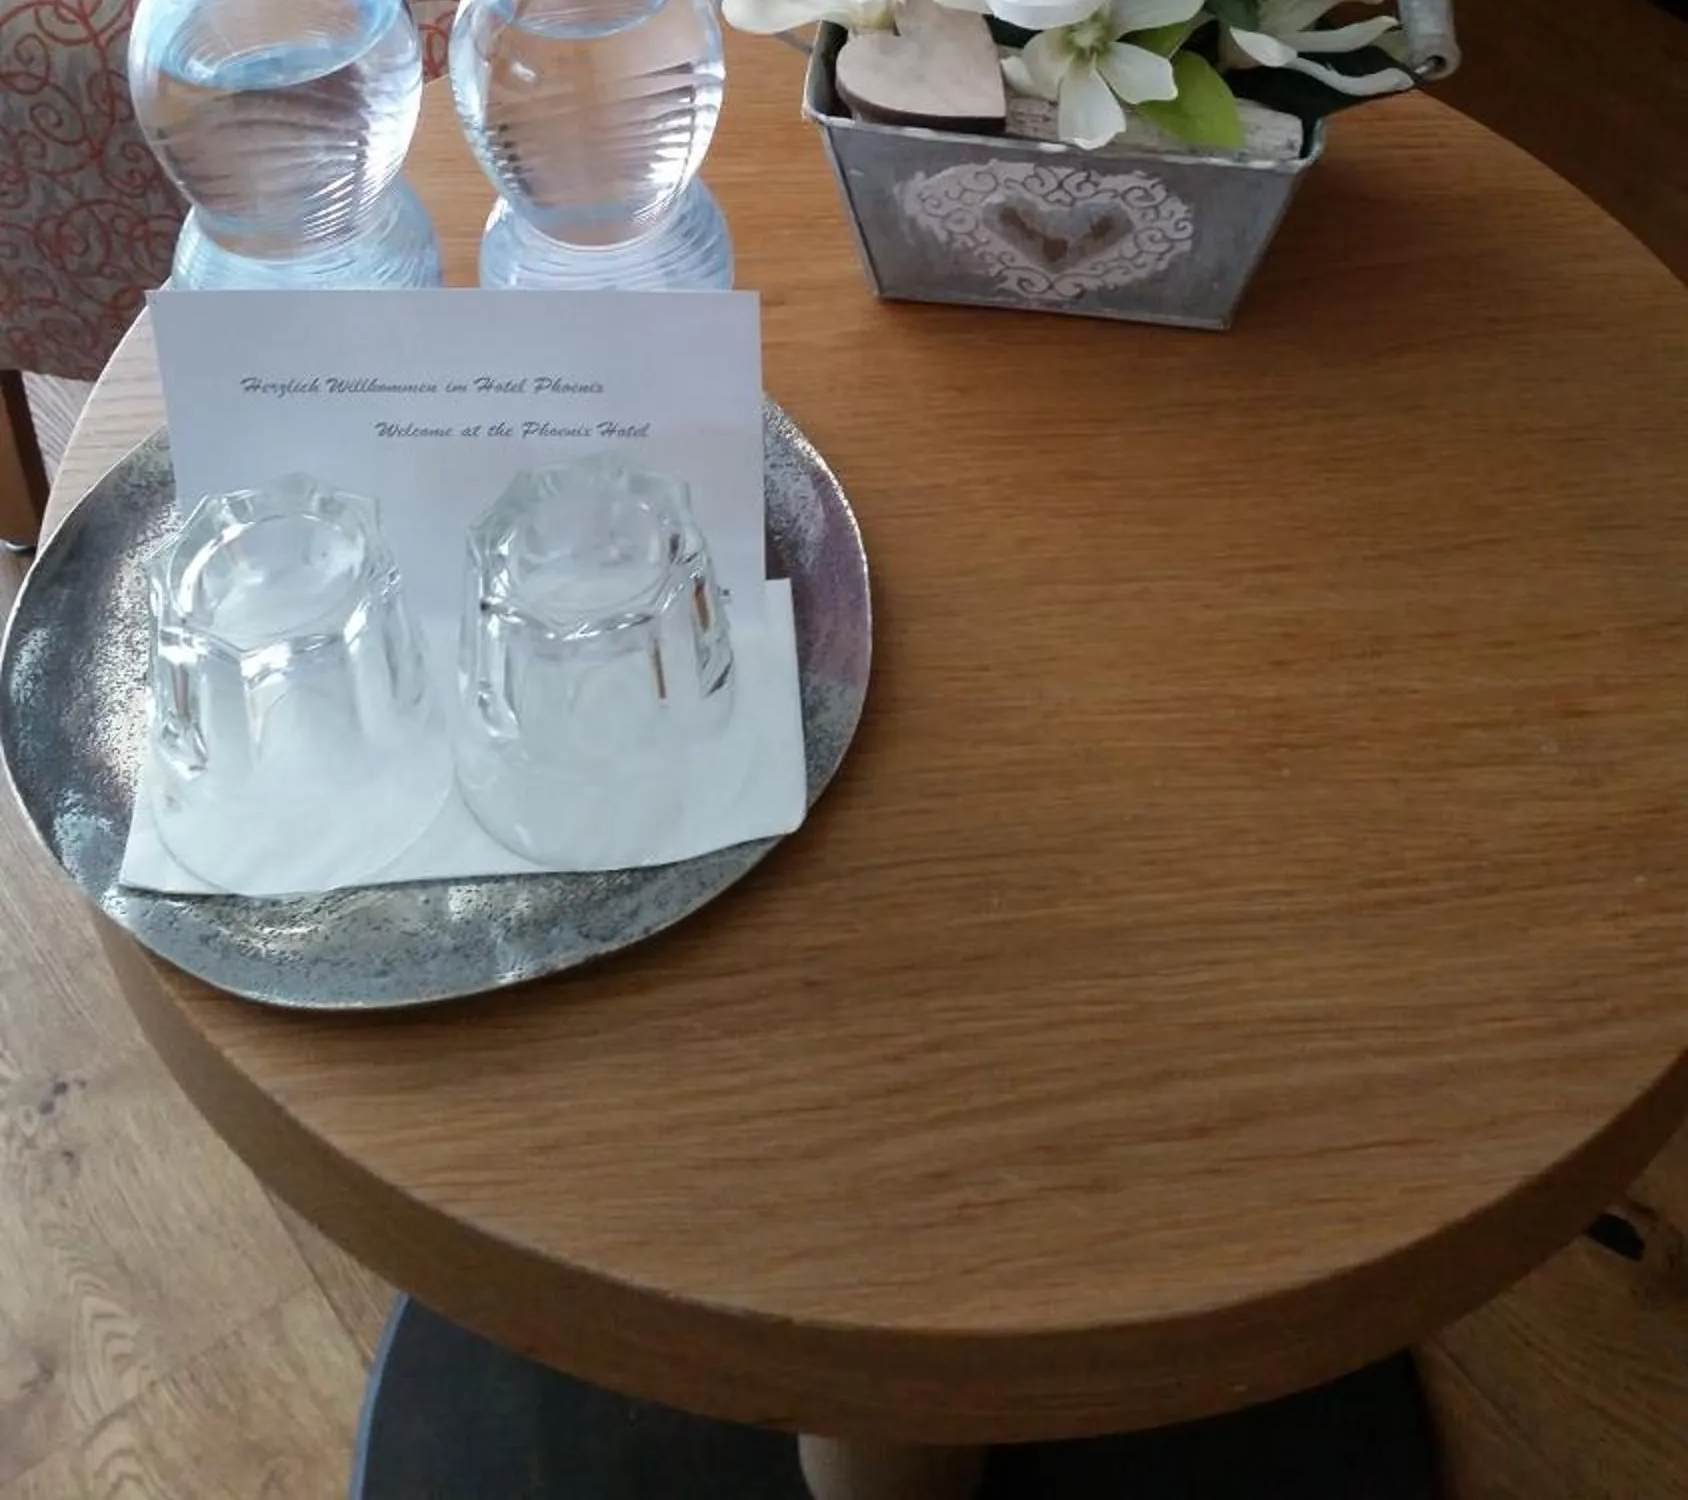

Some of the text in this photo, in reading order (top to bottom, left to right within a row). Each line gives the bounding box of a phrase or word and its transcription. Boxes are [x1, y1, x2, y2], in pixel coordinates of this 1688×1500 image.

[239, 376, 604, 399] Herzlich Willkommen im Hotel Phoenix
[374, 420, 651, 439] Welcome at the Phoenix Hotel
